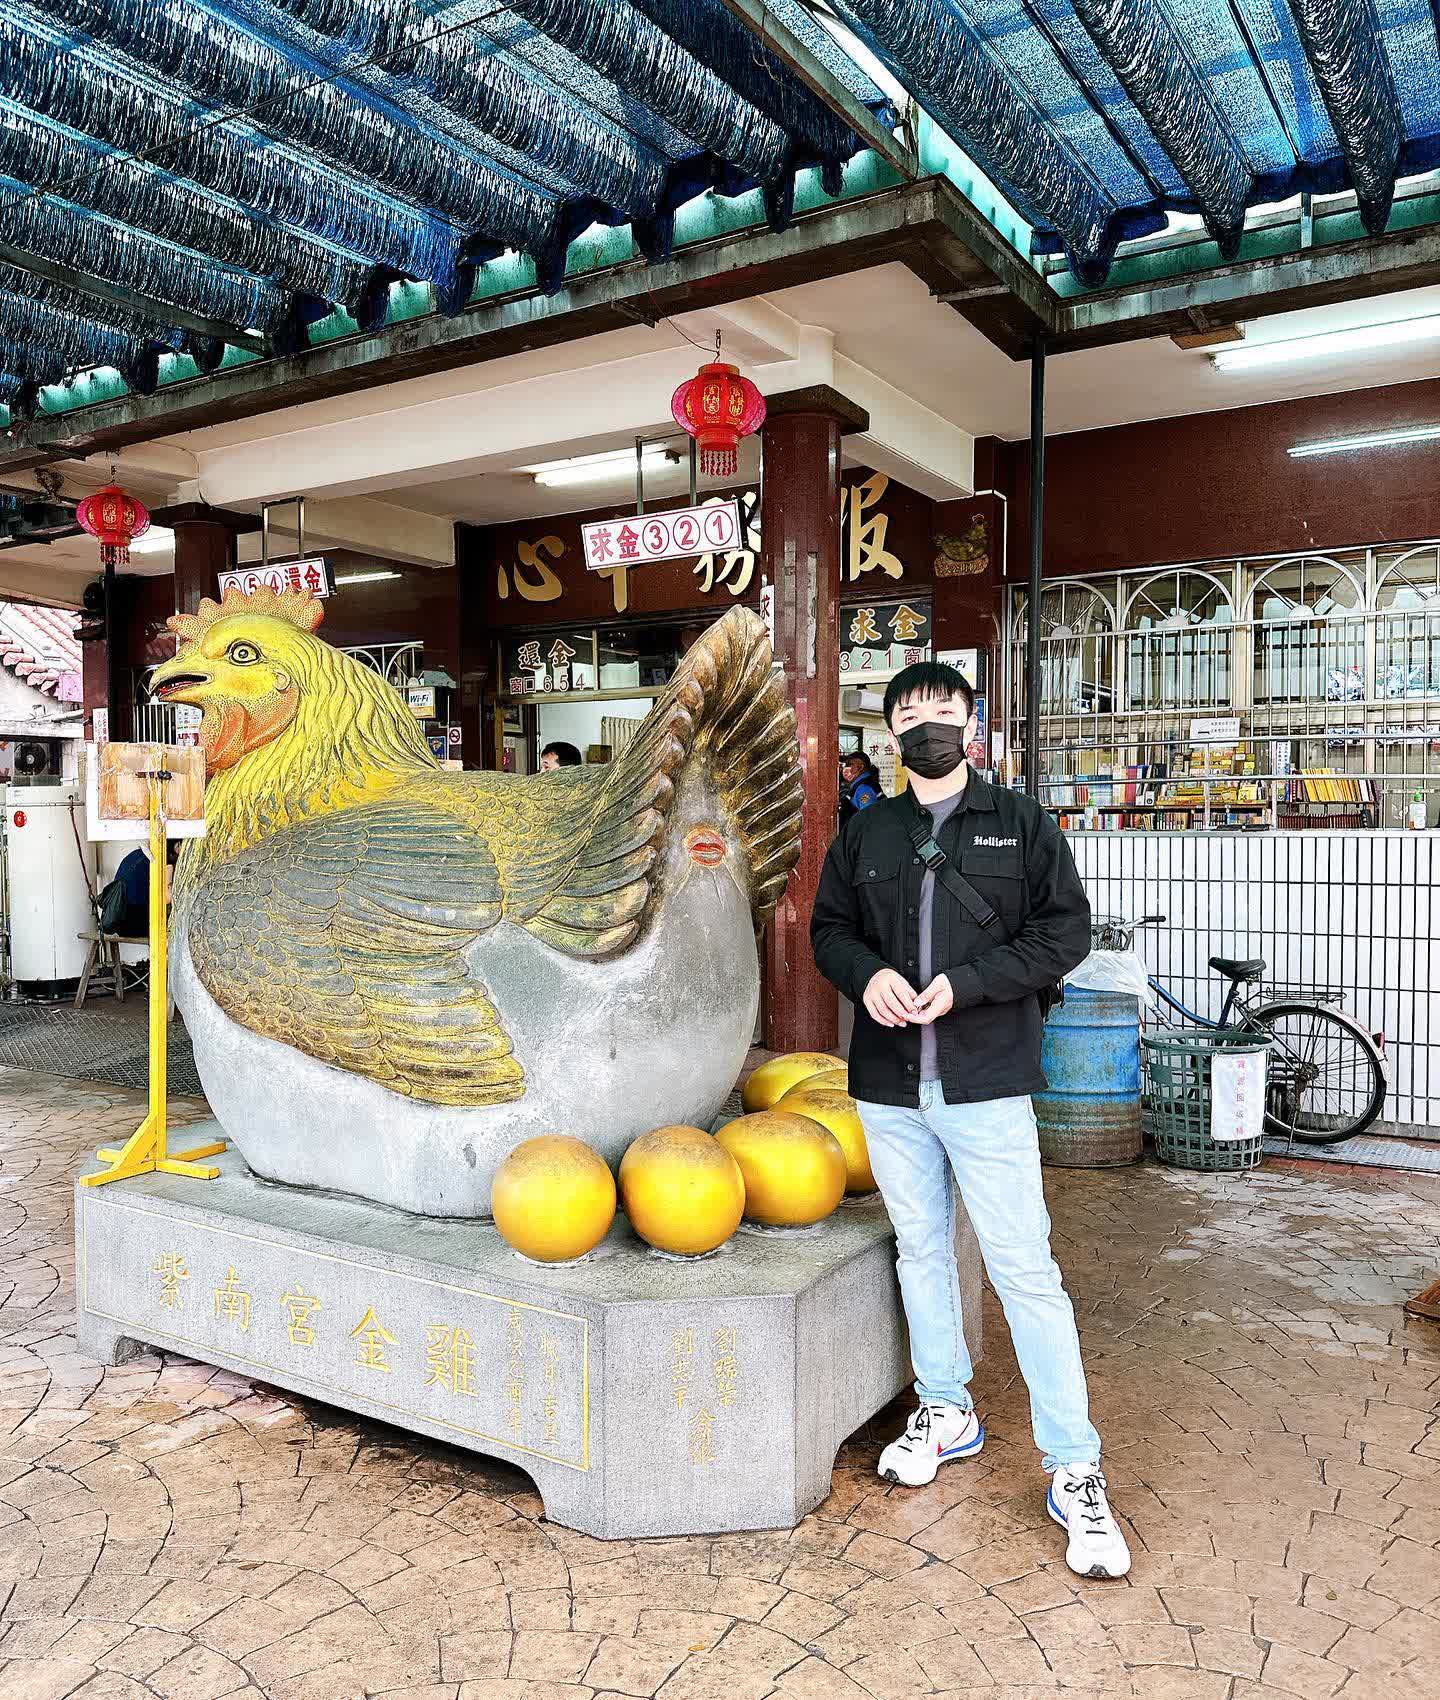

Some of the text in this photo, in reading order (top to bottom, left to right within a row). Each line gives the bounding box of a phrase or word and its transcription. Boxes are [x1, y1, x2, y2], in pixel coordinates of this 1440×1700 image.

[849, 604, 927, 645] 求金
[518, 639, 576, 671] 還金
[410, 694, 429, 703] Wi-Fi
[973, 835, 1018, 847] Hollister
[152, 1251, 480, 1397] 紫南宮金雞
